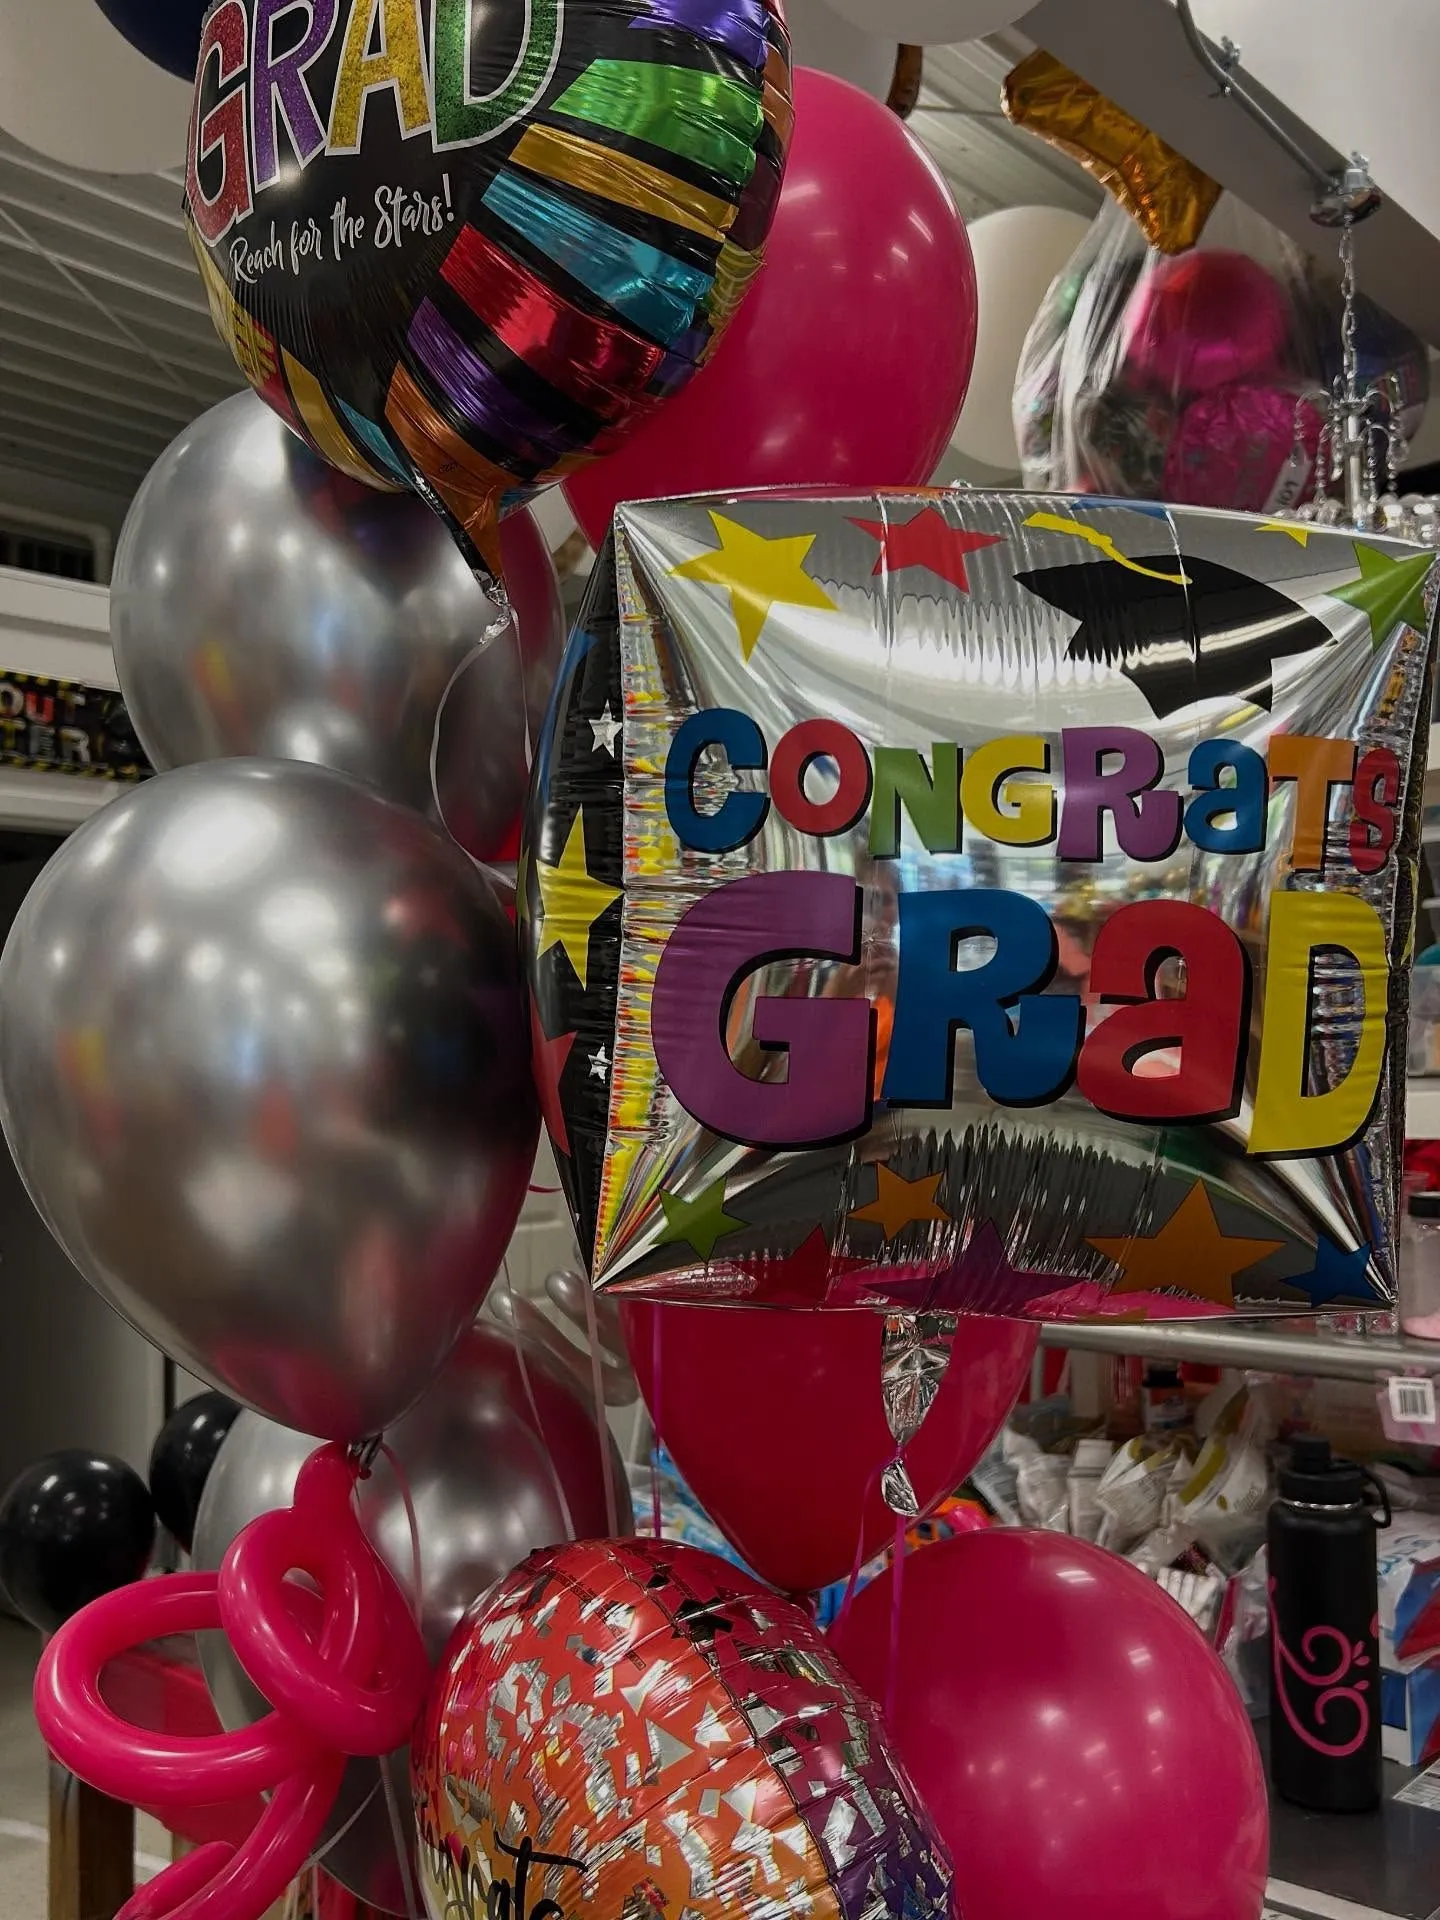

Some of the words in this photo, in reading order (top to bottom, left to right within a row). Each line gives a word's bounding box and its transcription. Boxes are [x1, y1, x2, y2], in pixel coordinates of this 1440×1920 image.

[187, 0, 565, 248] GRAD
[229, 220, 285, 284] Reach
[290, 217, 324, 276] for
[329, 196, 366, 261] the
[374, 173, 456, 250] Stars!
